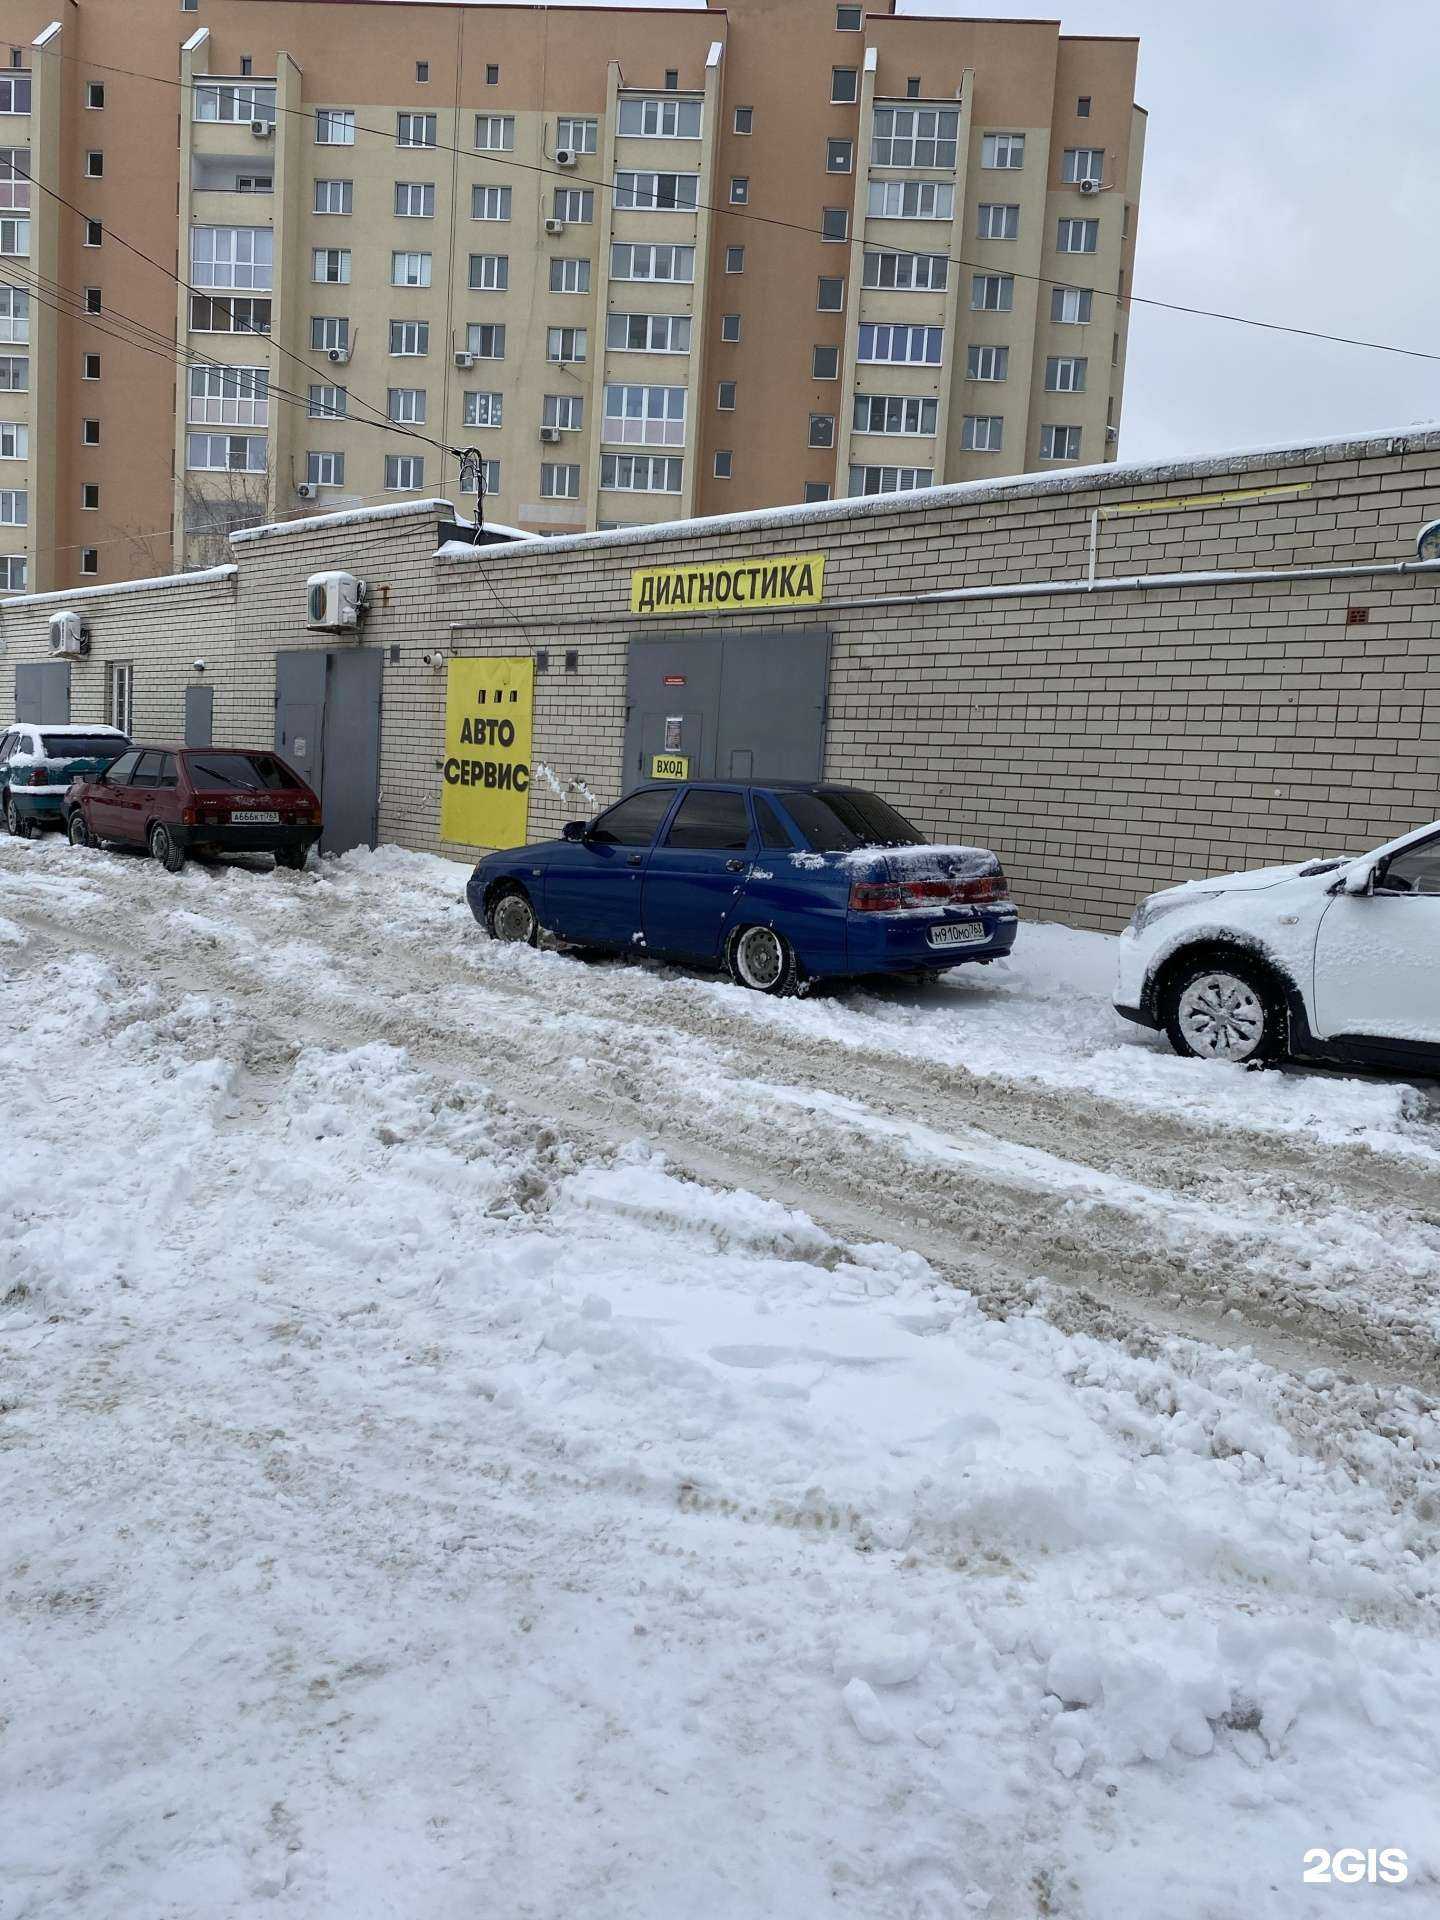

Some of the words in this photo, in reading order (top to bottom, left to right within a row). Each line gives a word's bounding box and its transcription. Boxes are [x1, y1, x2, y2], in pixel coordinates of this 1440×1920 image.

[638, 564, 814, 612] ДИАГНОСТИКА
[460, 717, 515, 747] АВТО
[444, 758, 530, 793] СЕРВИС
[657, 759, 683, 777] ВХОД
